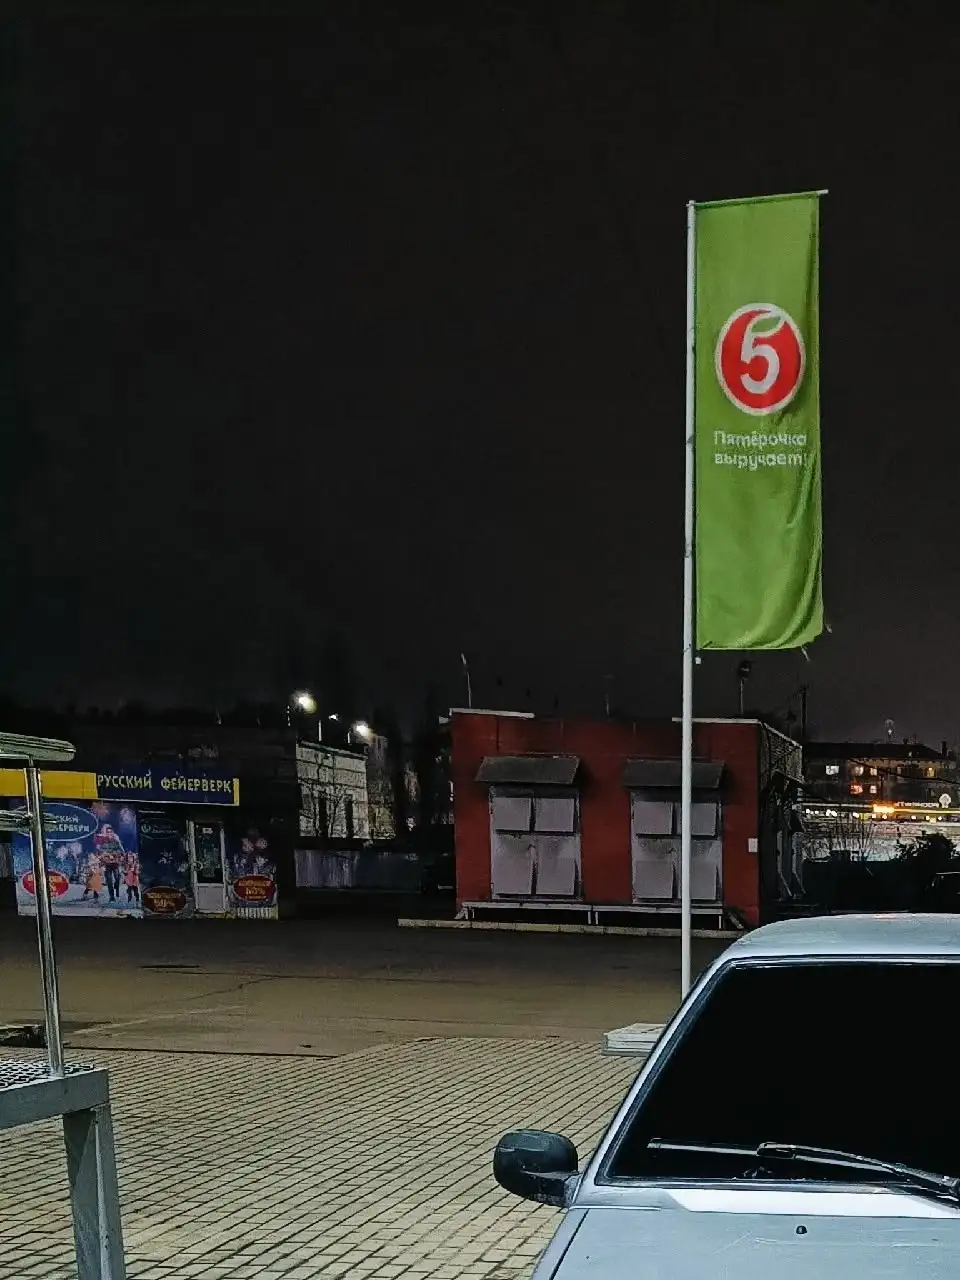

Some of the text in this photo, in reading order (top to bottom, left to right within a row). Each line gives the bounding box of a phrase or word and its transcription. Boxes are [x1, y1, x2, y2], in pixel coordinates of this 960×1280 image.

[713, 430, 808, 451] Пятёрочка
[97, 768, 232, 794] РУССКИЙ ФЕЙЕРВЕРК
